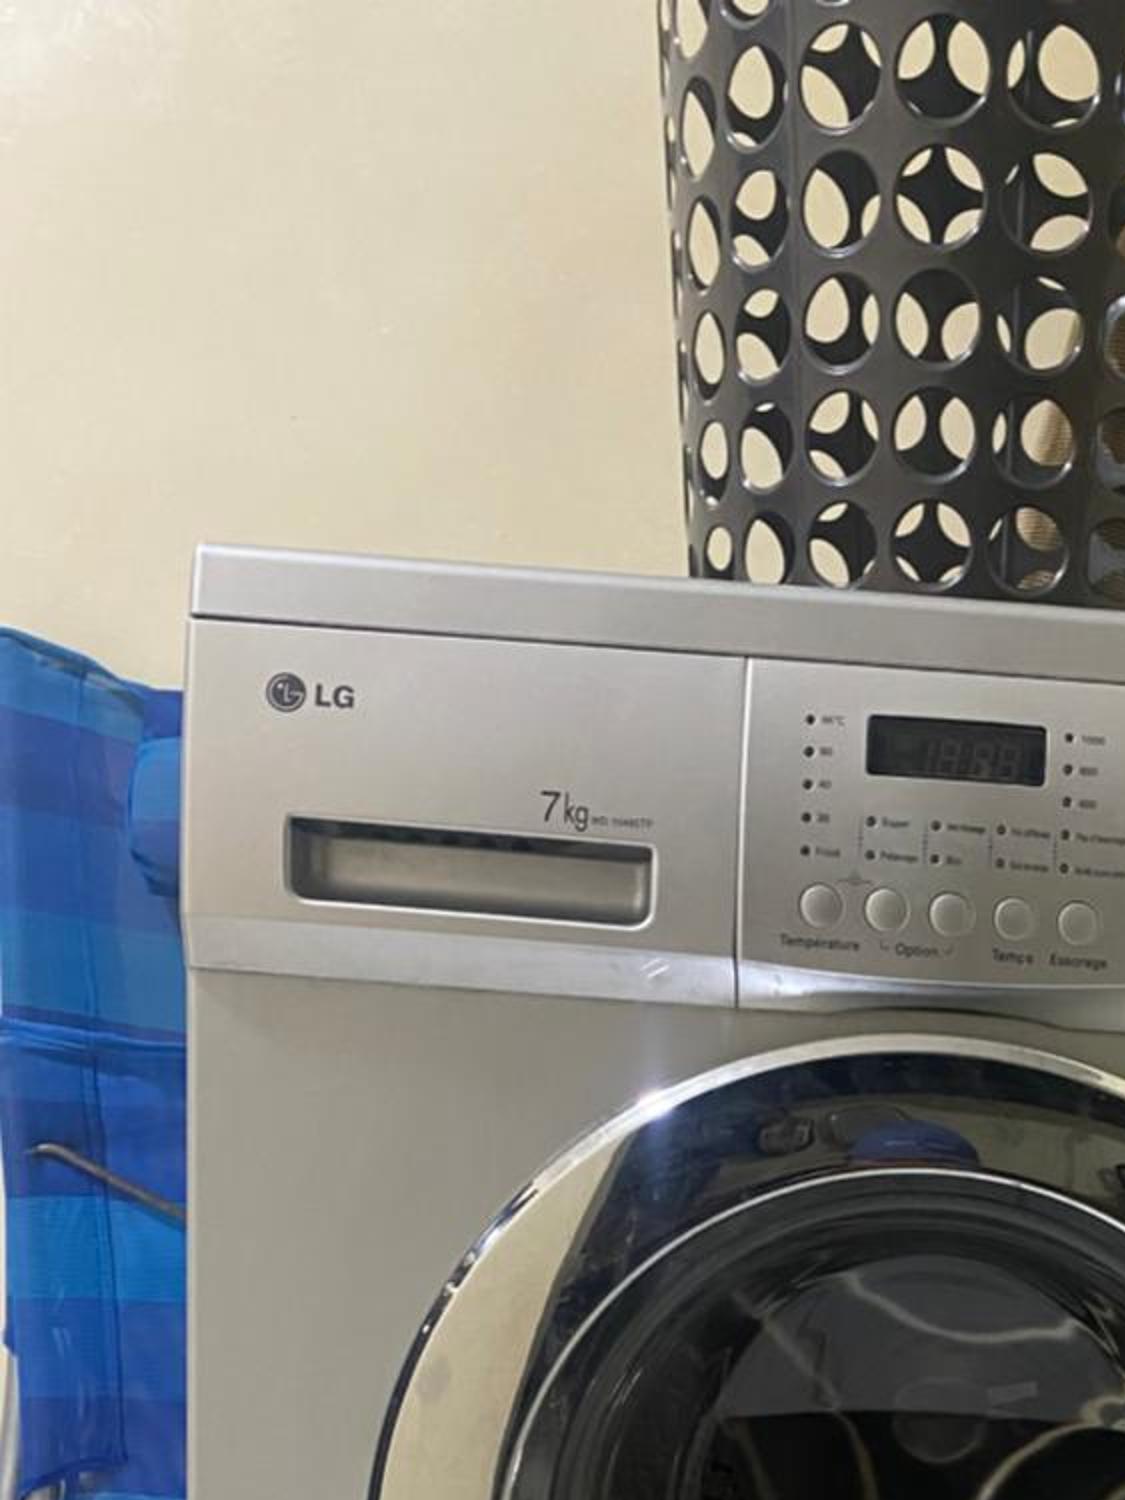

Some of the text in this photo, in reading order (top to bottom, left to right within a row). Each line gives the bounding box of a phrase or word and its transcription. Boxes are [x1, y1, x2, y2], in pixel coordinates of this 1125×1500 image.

[315, 683, 355, 709] LG
[780, 932, 860, 952] Température
[895, 942, 939, 959] Option
[992, 947, 1034, 967] Temps
[1049, 953, 1108, 973] Essorage
